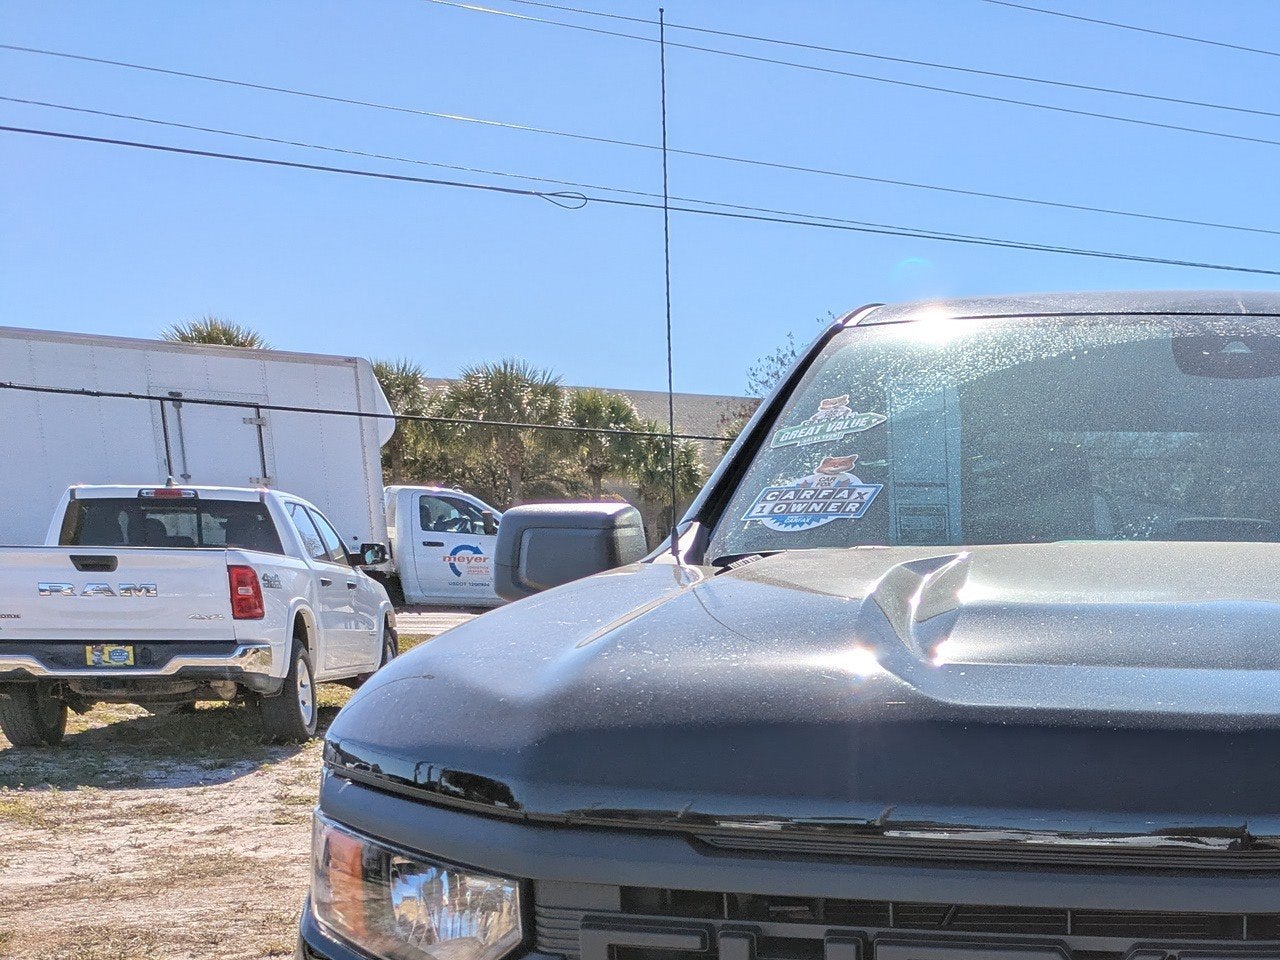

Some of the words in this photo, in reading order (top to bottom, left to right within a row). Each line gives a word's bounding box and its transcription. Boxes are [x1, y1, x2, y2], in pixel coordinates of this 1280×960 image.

[779, 425, 822, 442] GREAT
[826, 417, 870, 432] VALUE
[766, 490, 869, 501] CARFAX
[773, 502, 862, 513] OWNER
[442, 555, 490, 565] meyer
[37, 581, 159, 598] RAM
